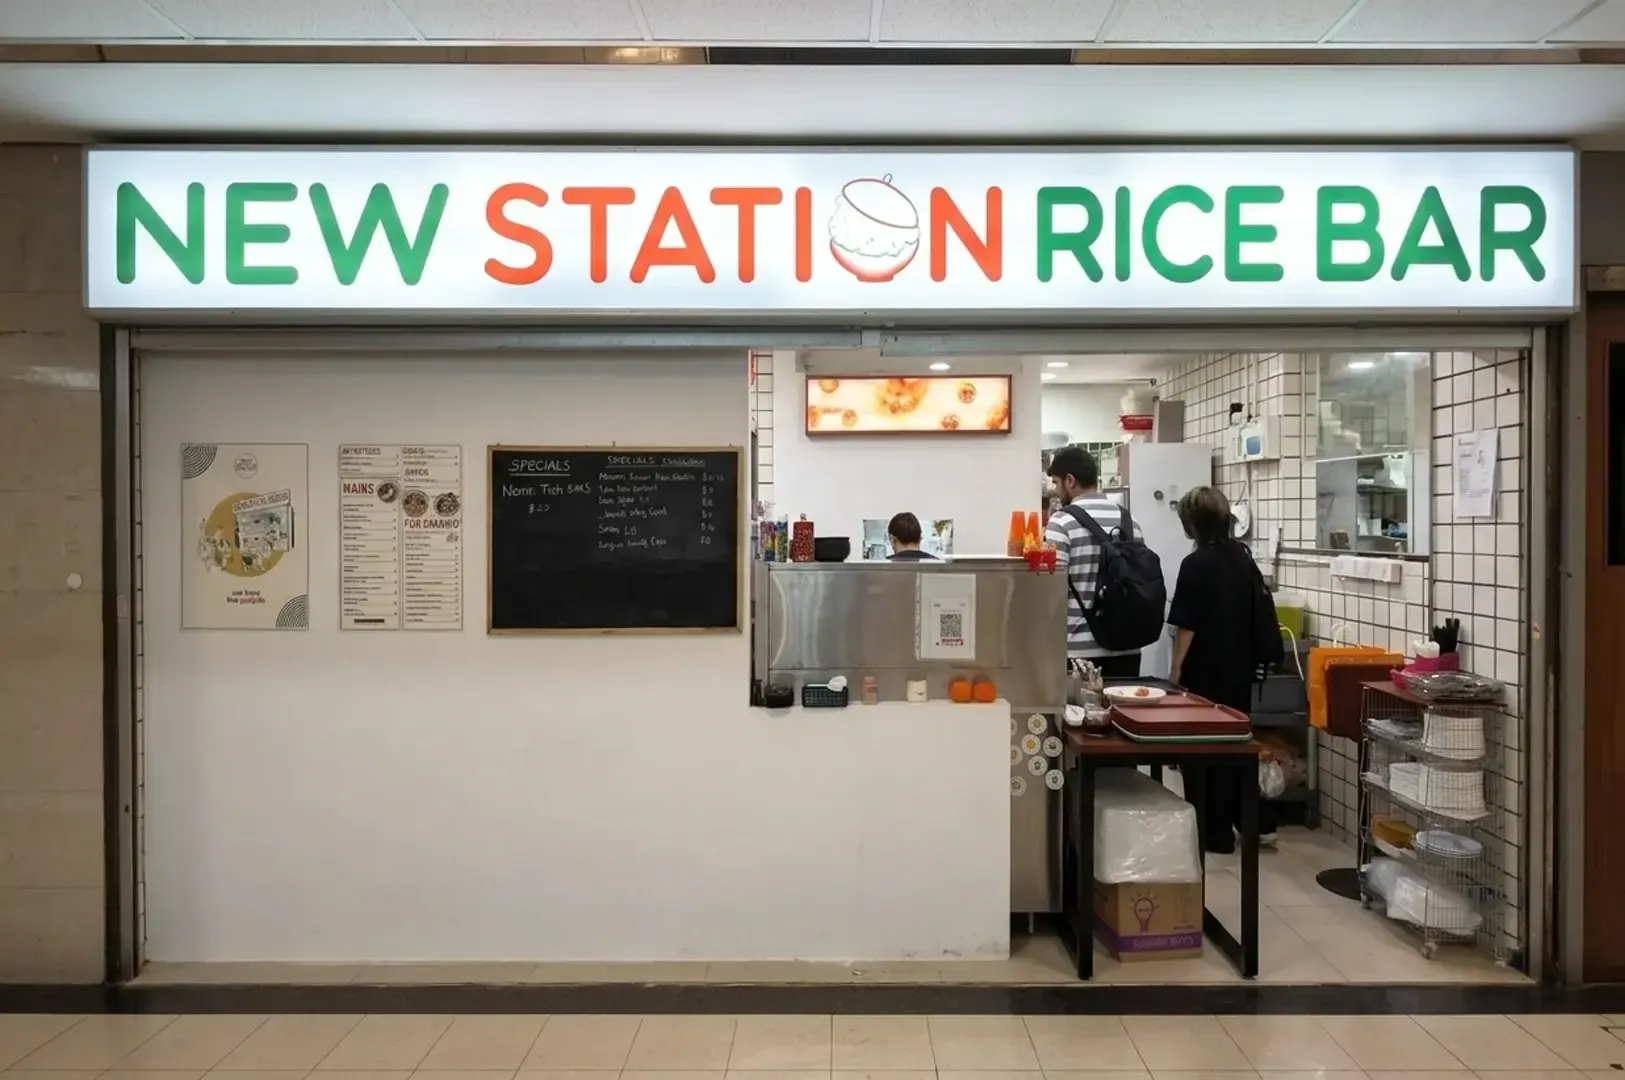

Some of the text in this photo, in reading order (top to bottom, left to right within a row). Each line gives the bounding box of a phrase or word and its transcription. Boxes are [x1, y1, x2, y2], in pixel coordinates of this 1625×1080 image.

[116, 182, 450, 285] NEW
[1036, 185, 1284, 283] RICE
[1316, 185, 1546, 282] BAR
[508, 459, 571, 472] SPECIALS
[342, 483, 375, 495] MAINS
